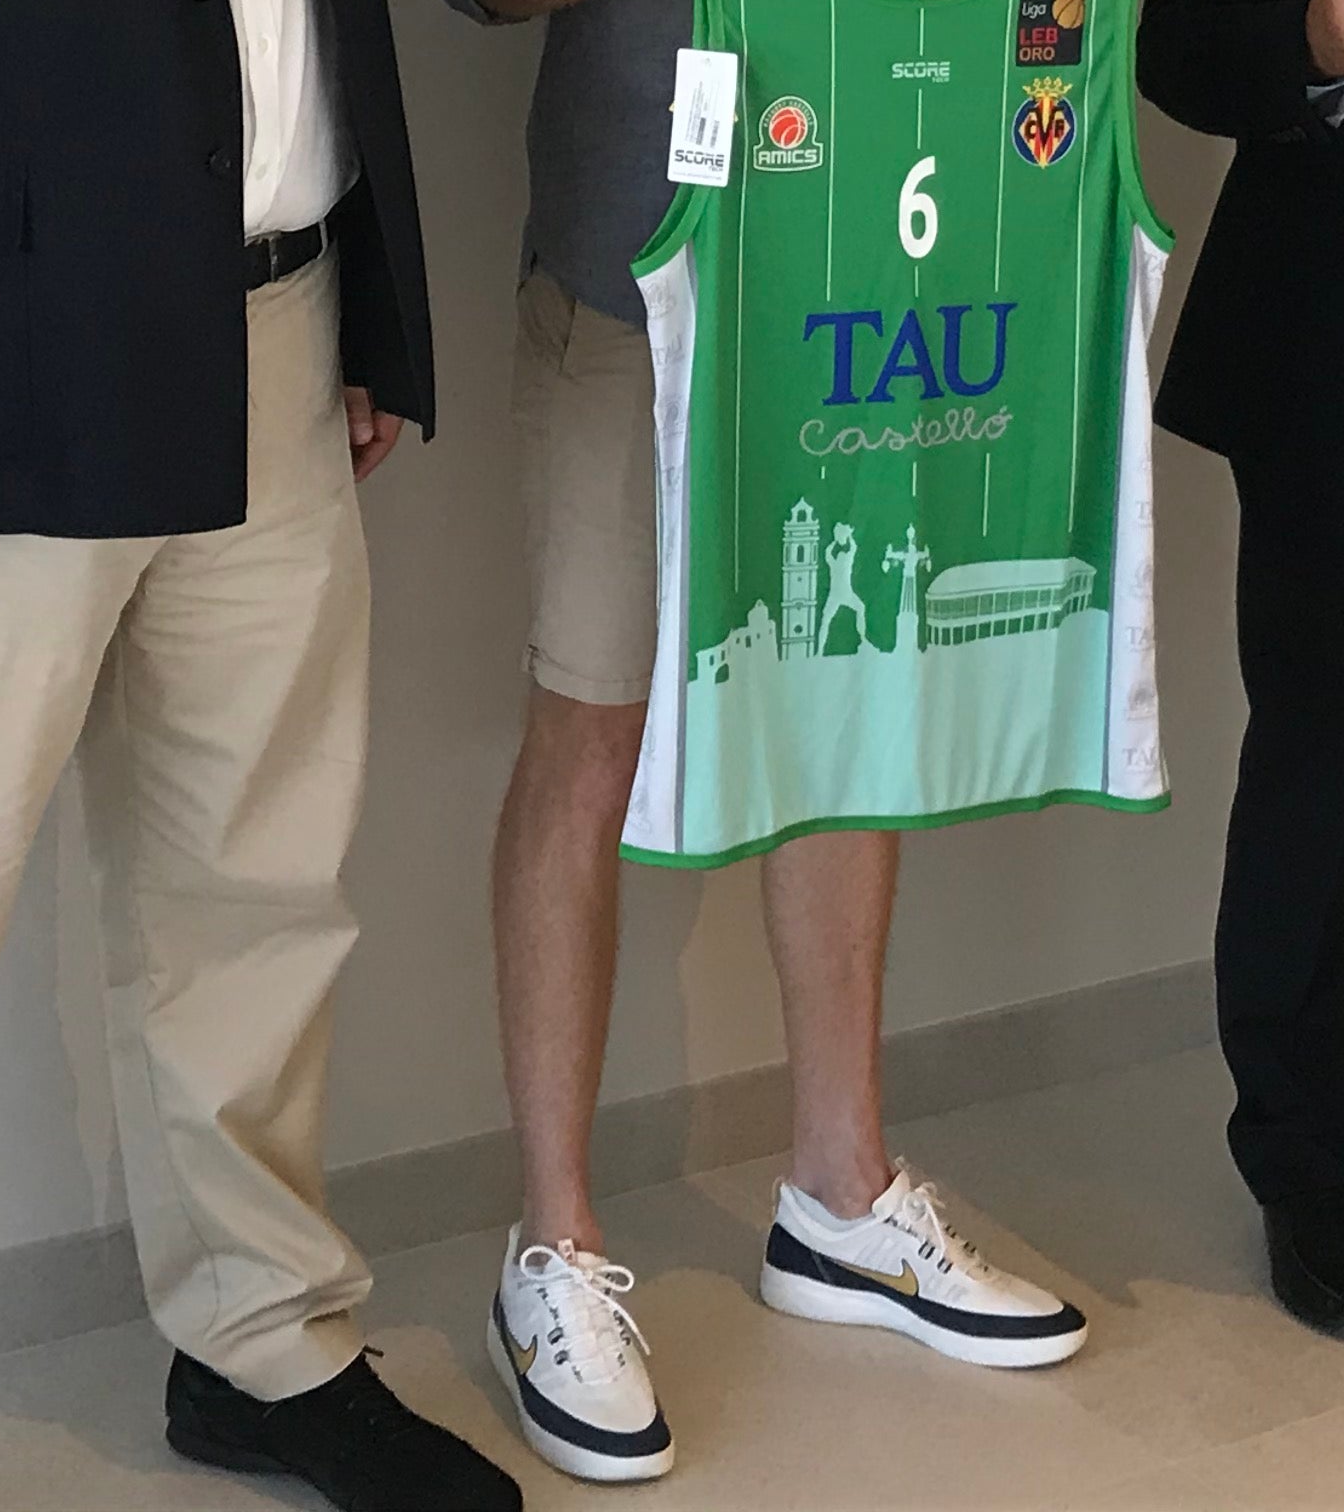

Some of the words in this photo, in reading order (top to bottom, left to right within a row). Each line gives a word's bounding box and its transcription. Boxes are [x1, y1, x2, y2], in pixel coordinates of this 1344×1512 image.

[1019, 27, 1058, 45] LEB
[1019, 46, 1056, 61] ORO
[891, 61, 951, 79] SCORE
[674, 149, 726, 168] SCORE
[758, 149, 817, 166] AMICS
[898, 155, 939, 259] 6
[803, 302, 1018, 406] TAU
[799, 405, 1013, 456] Castelló
